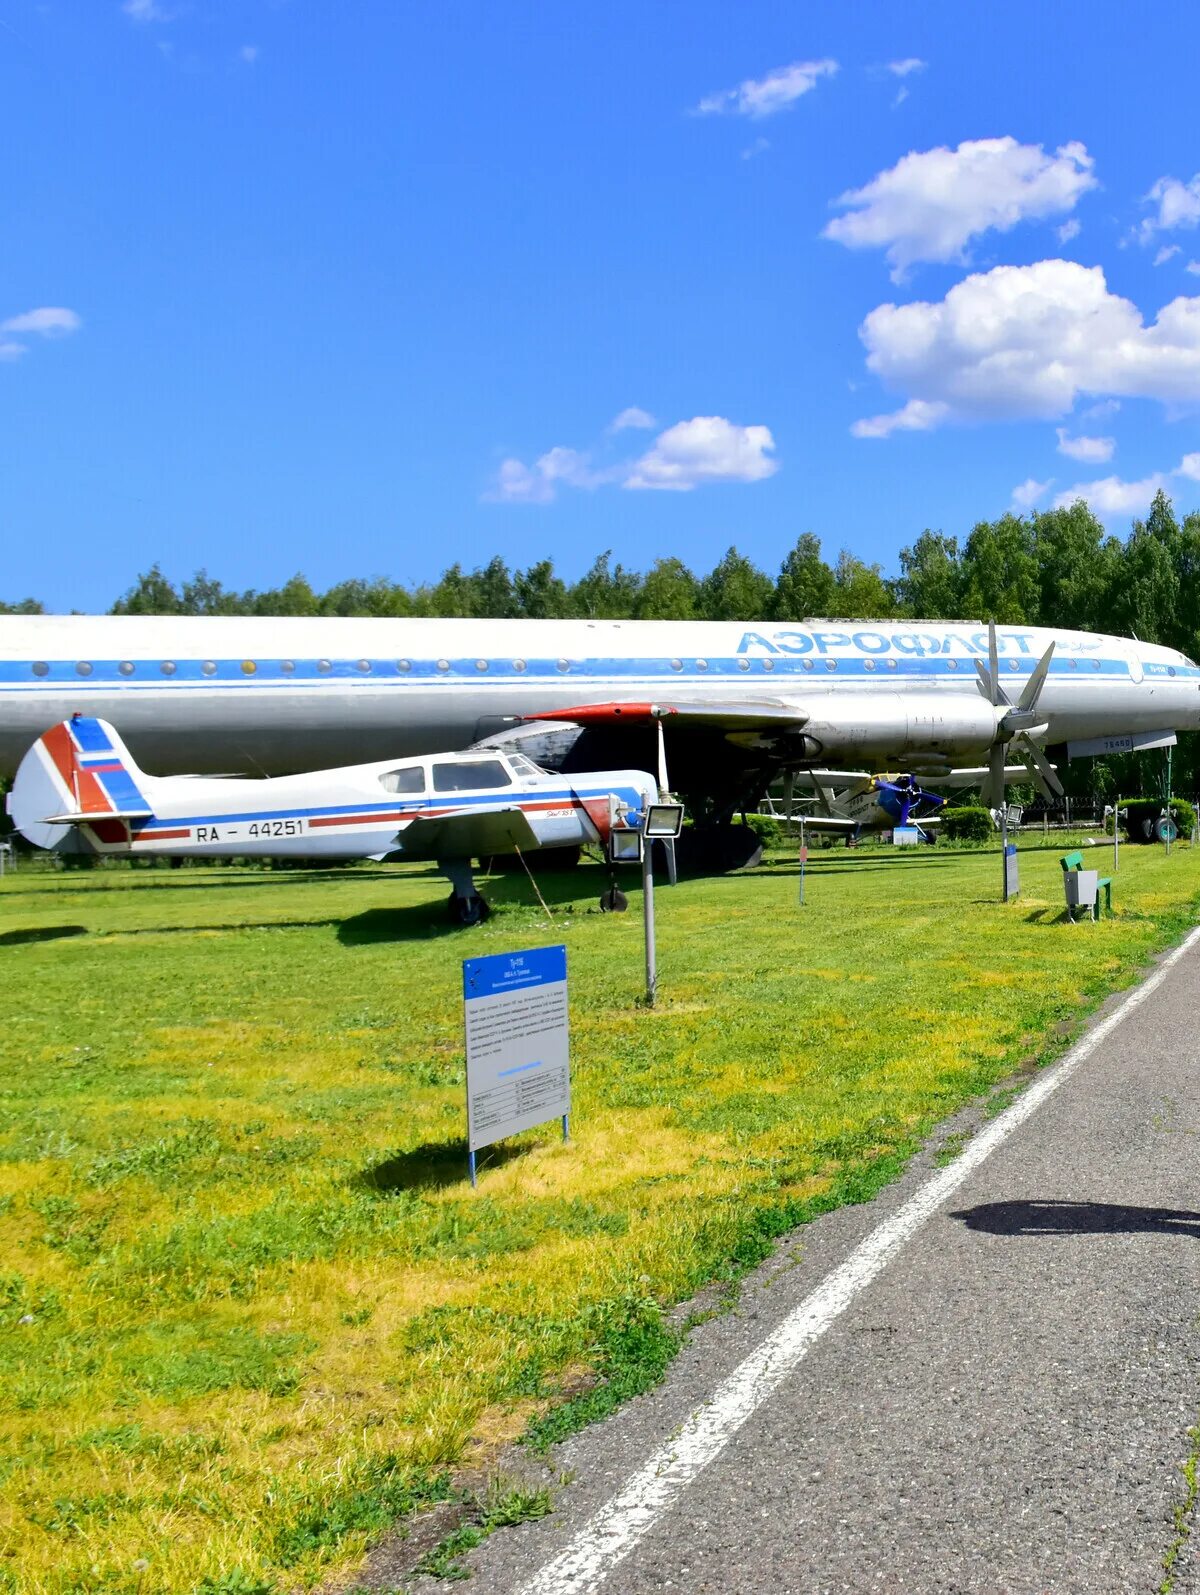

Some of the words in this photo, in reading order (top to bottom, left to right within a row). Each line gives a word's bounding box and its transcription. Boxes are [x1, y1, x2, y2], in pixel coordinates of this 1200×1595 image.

[736, 631, 1034, 657] АЭРОФЛОТ
[197, 827, 220, 842] RA
[248, 820, 303, 838] 44251
